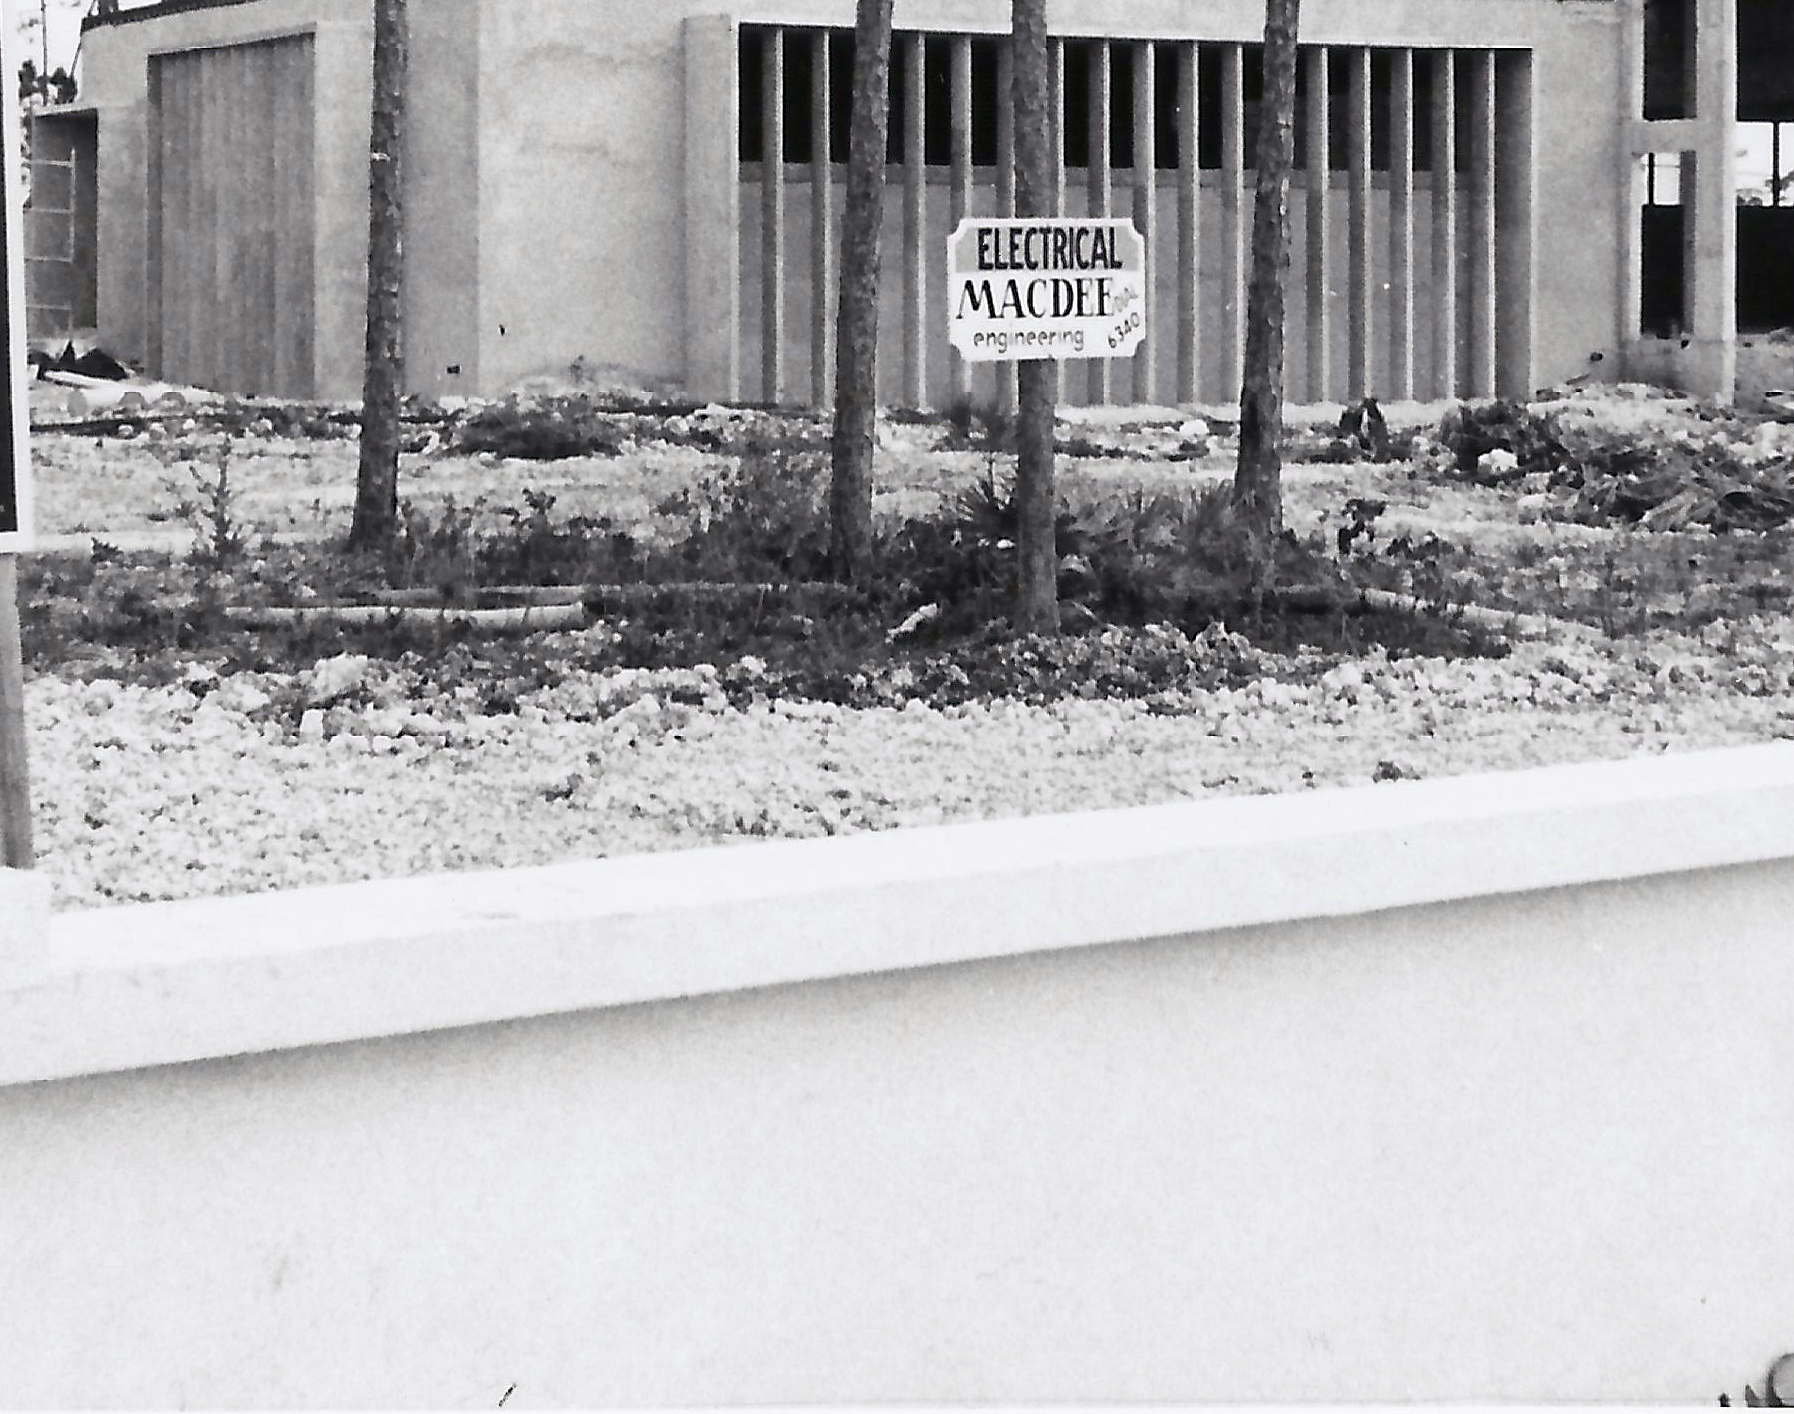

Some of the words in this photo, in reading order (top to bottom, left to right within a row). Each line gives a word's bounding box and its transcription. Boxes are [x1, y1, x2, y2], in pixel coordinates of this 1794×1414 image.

[977, 226, 1123, 271] ELECTRICAL
[955, 276, 1114, 320] MACDEE
[972, 329, 1085, 354] engineering
